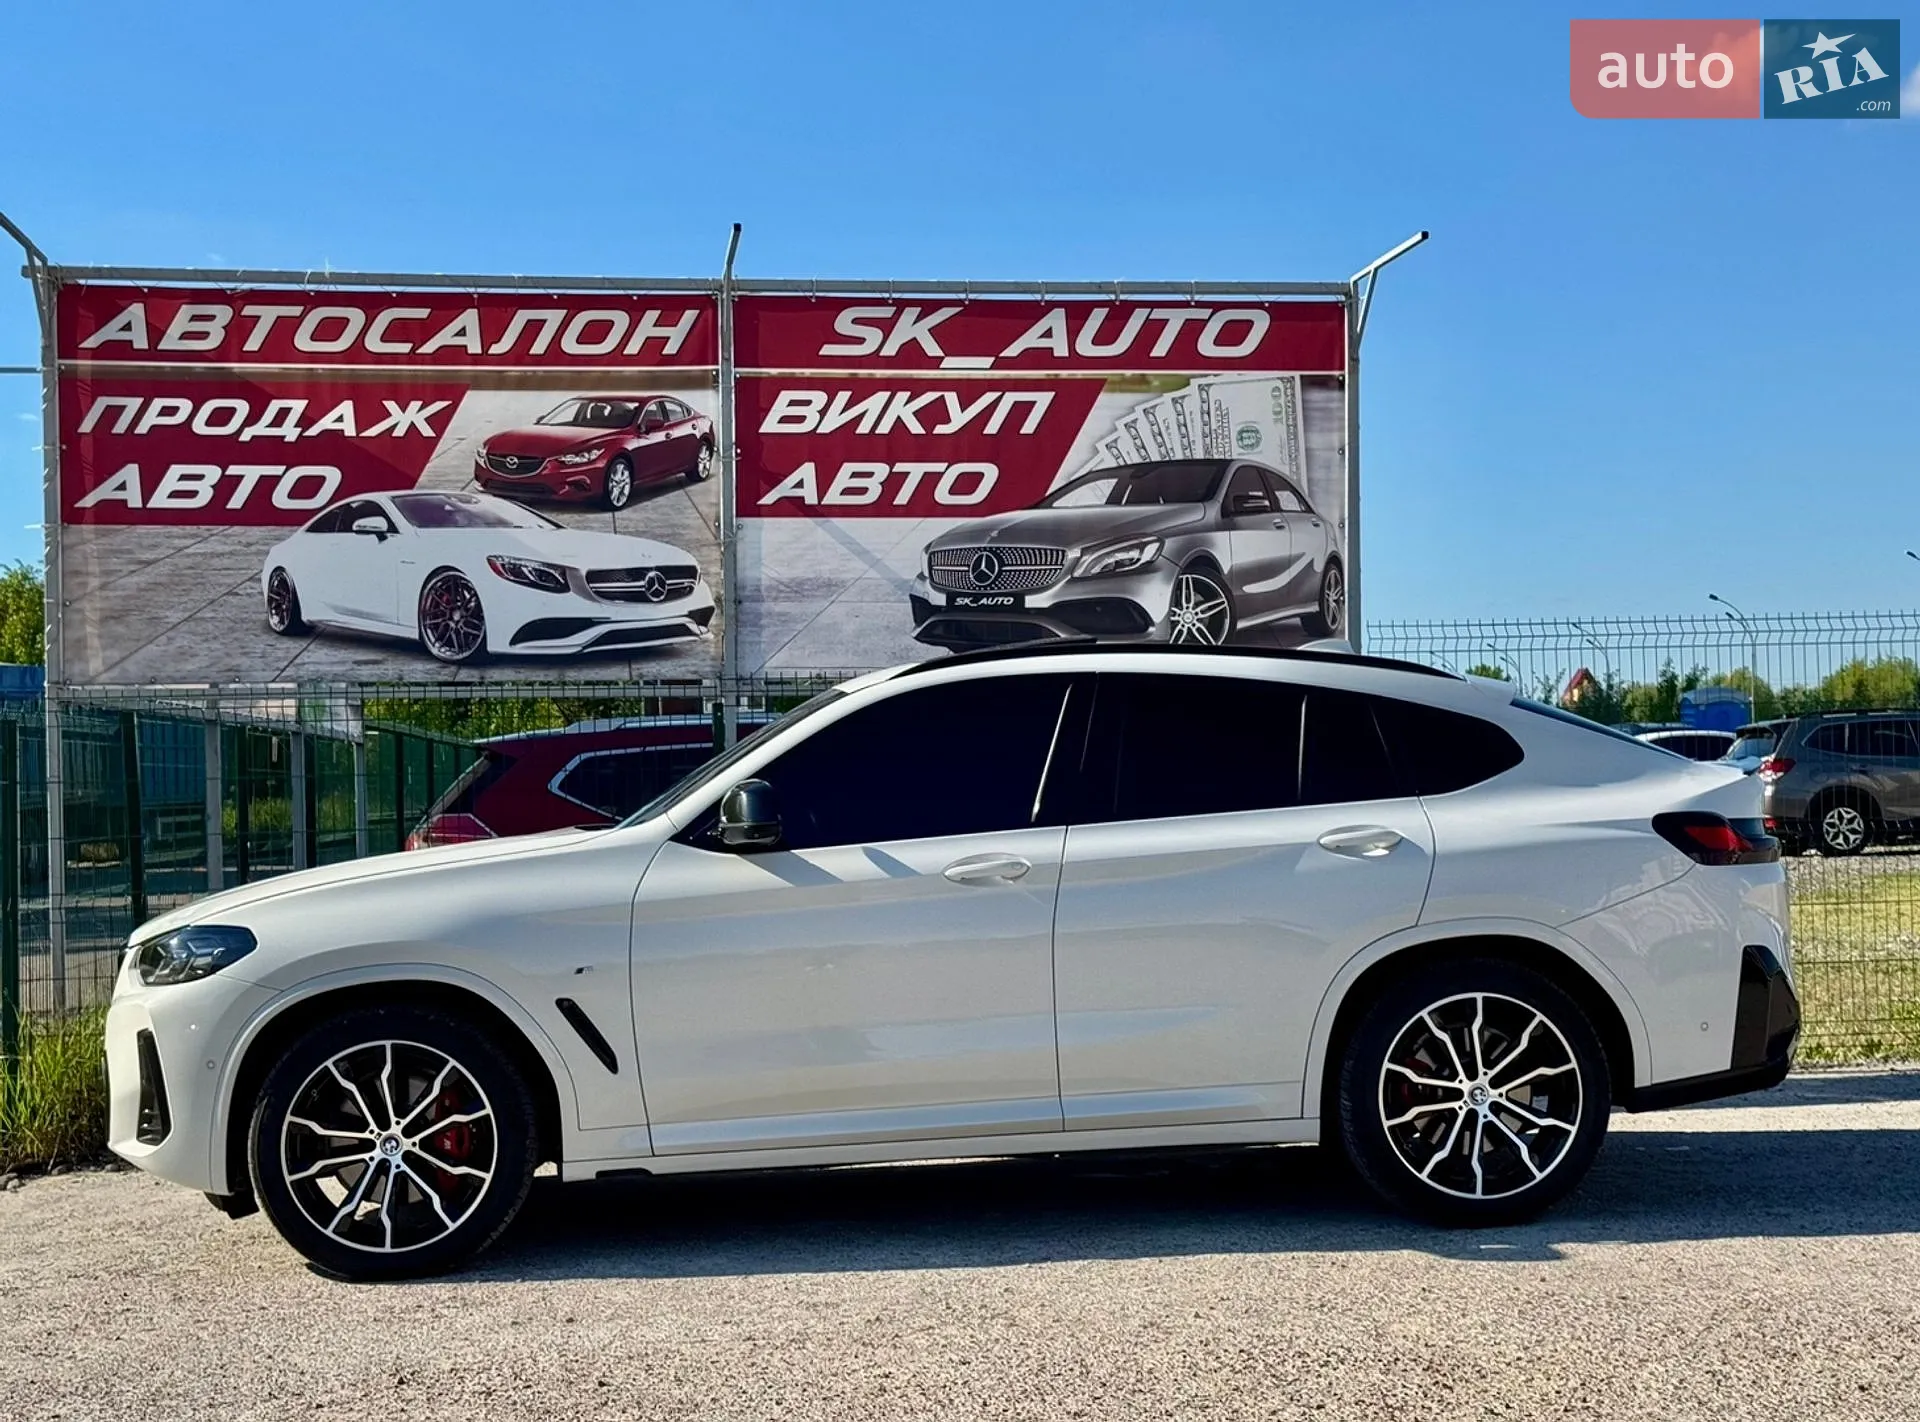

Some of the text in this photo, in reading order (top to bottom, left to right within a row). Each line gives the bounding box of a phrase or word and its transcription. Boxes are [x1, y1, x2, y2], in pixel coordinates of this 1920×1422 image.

[79, 302, 699, 356] АВТОСАЛОН
[819, 305, 1271, 369] SK_AUTO
[78, 396, 452, 441] ПРОДАЖ
[758, 390, 1056, 435] ВИКУП
[75, 463, 342, 509] АВТО
[757, 462, 1000, 505] АВТО
[954, 596, 1014, 607] SK_AUTO
